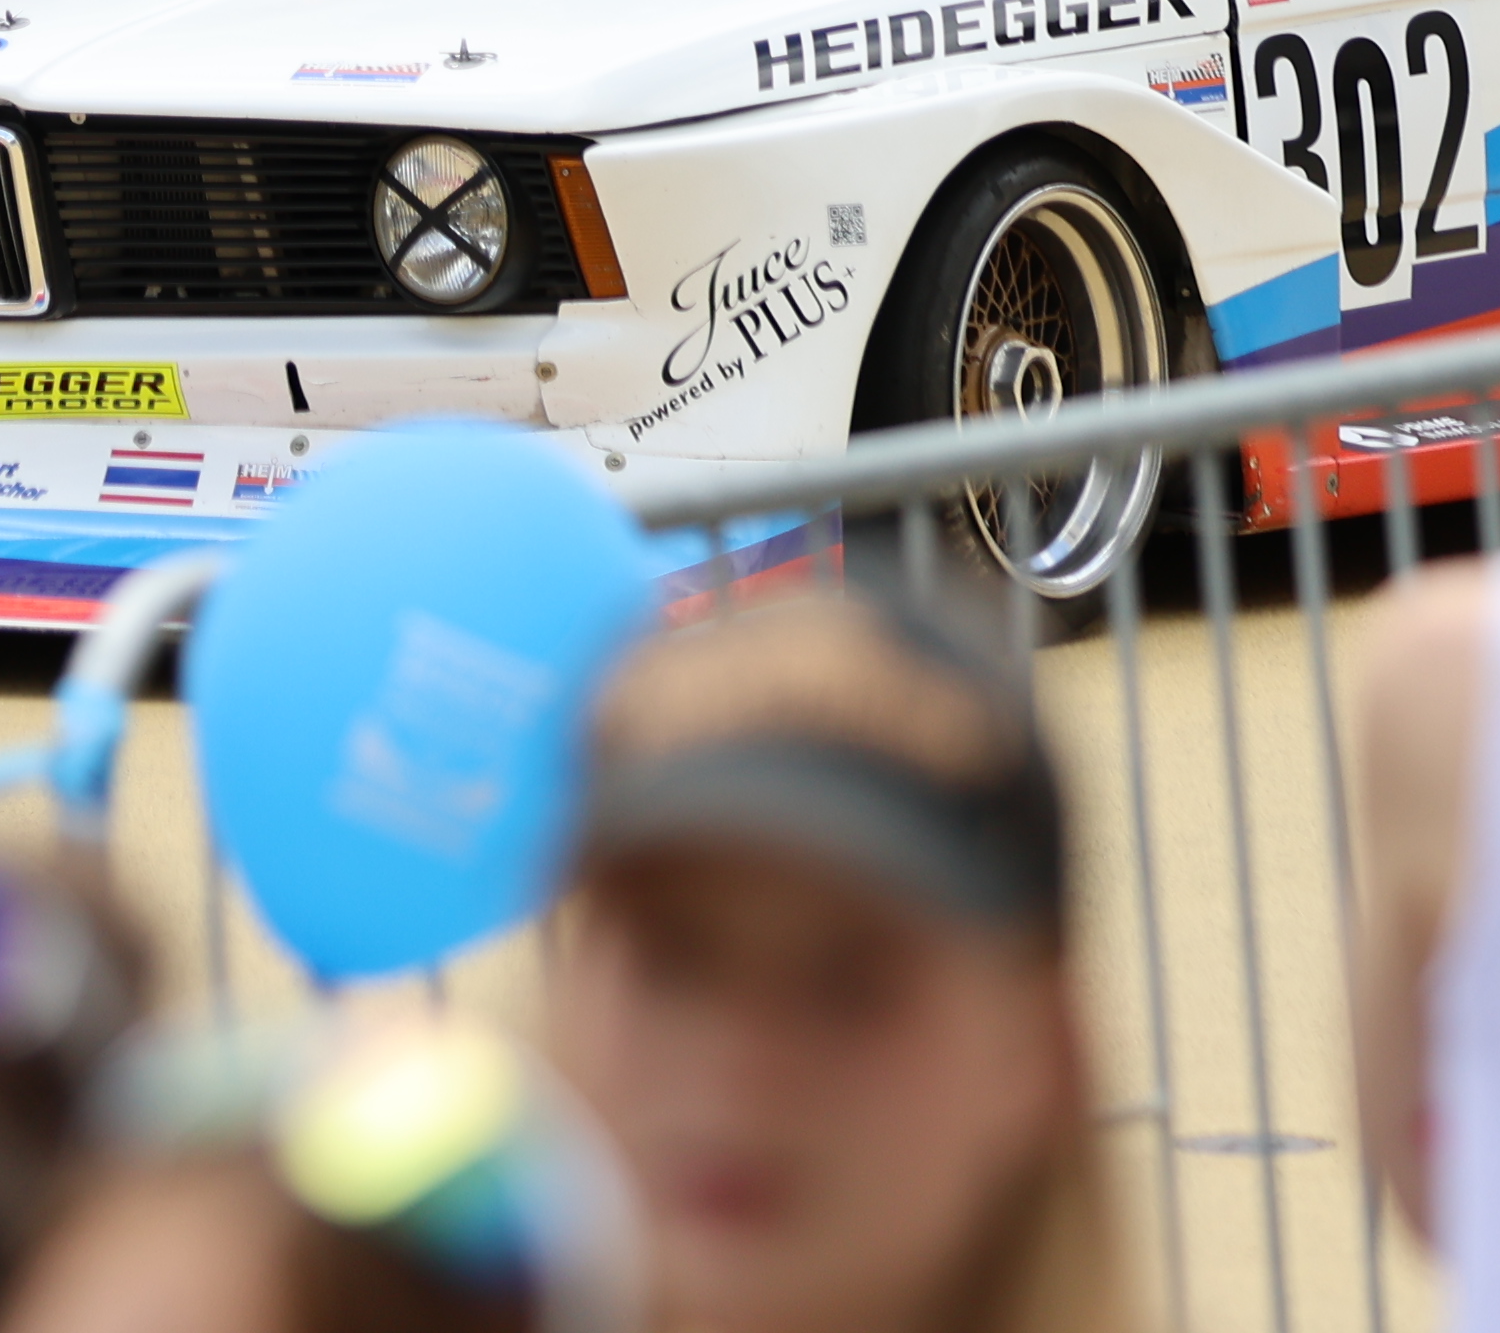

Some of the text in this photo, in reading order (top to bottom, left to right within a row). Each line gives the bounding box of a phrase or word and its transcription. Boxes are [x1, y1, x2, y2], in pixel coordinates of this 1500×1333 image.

[1254, 9, 1481, 287] 302
[662, 234, 810, 388] Juice
[5, 395, 172, 412] motor
[627, 355, 747, 442] powered by
